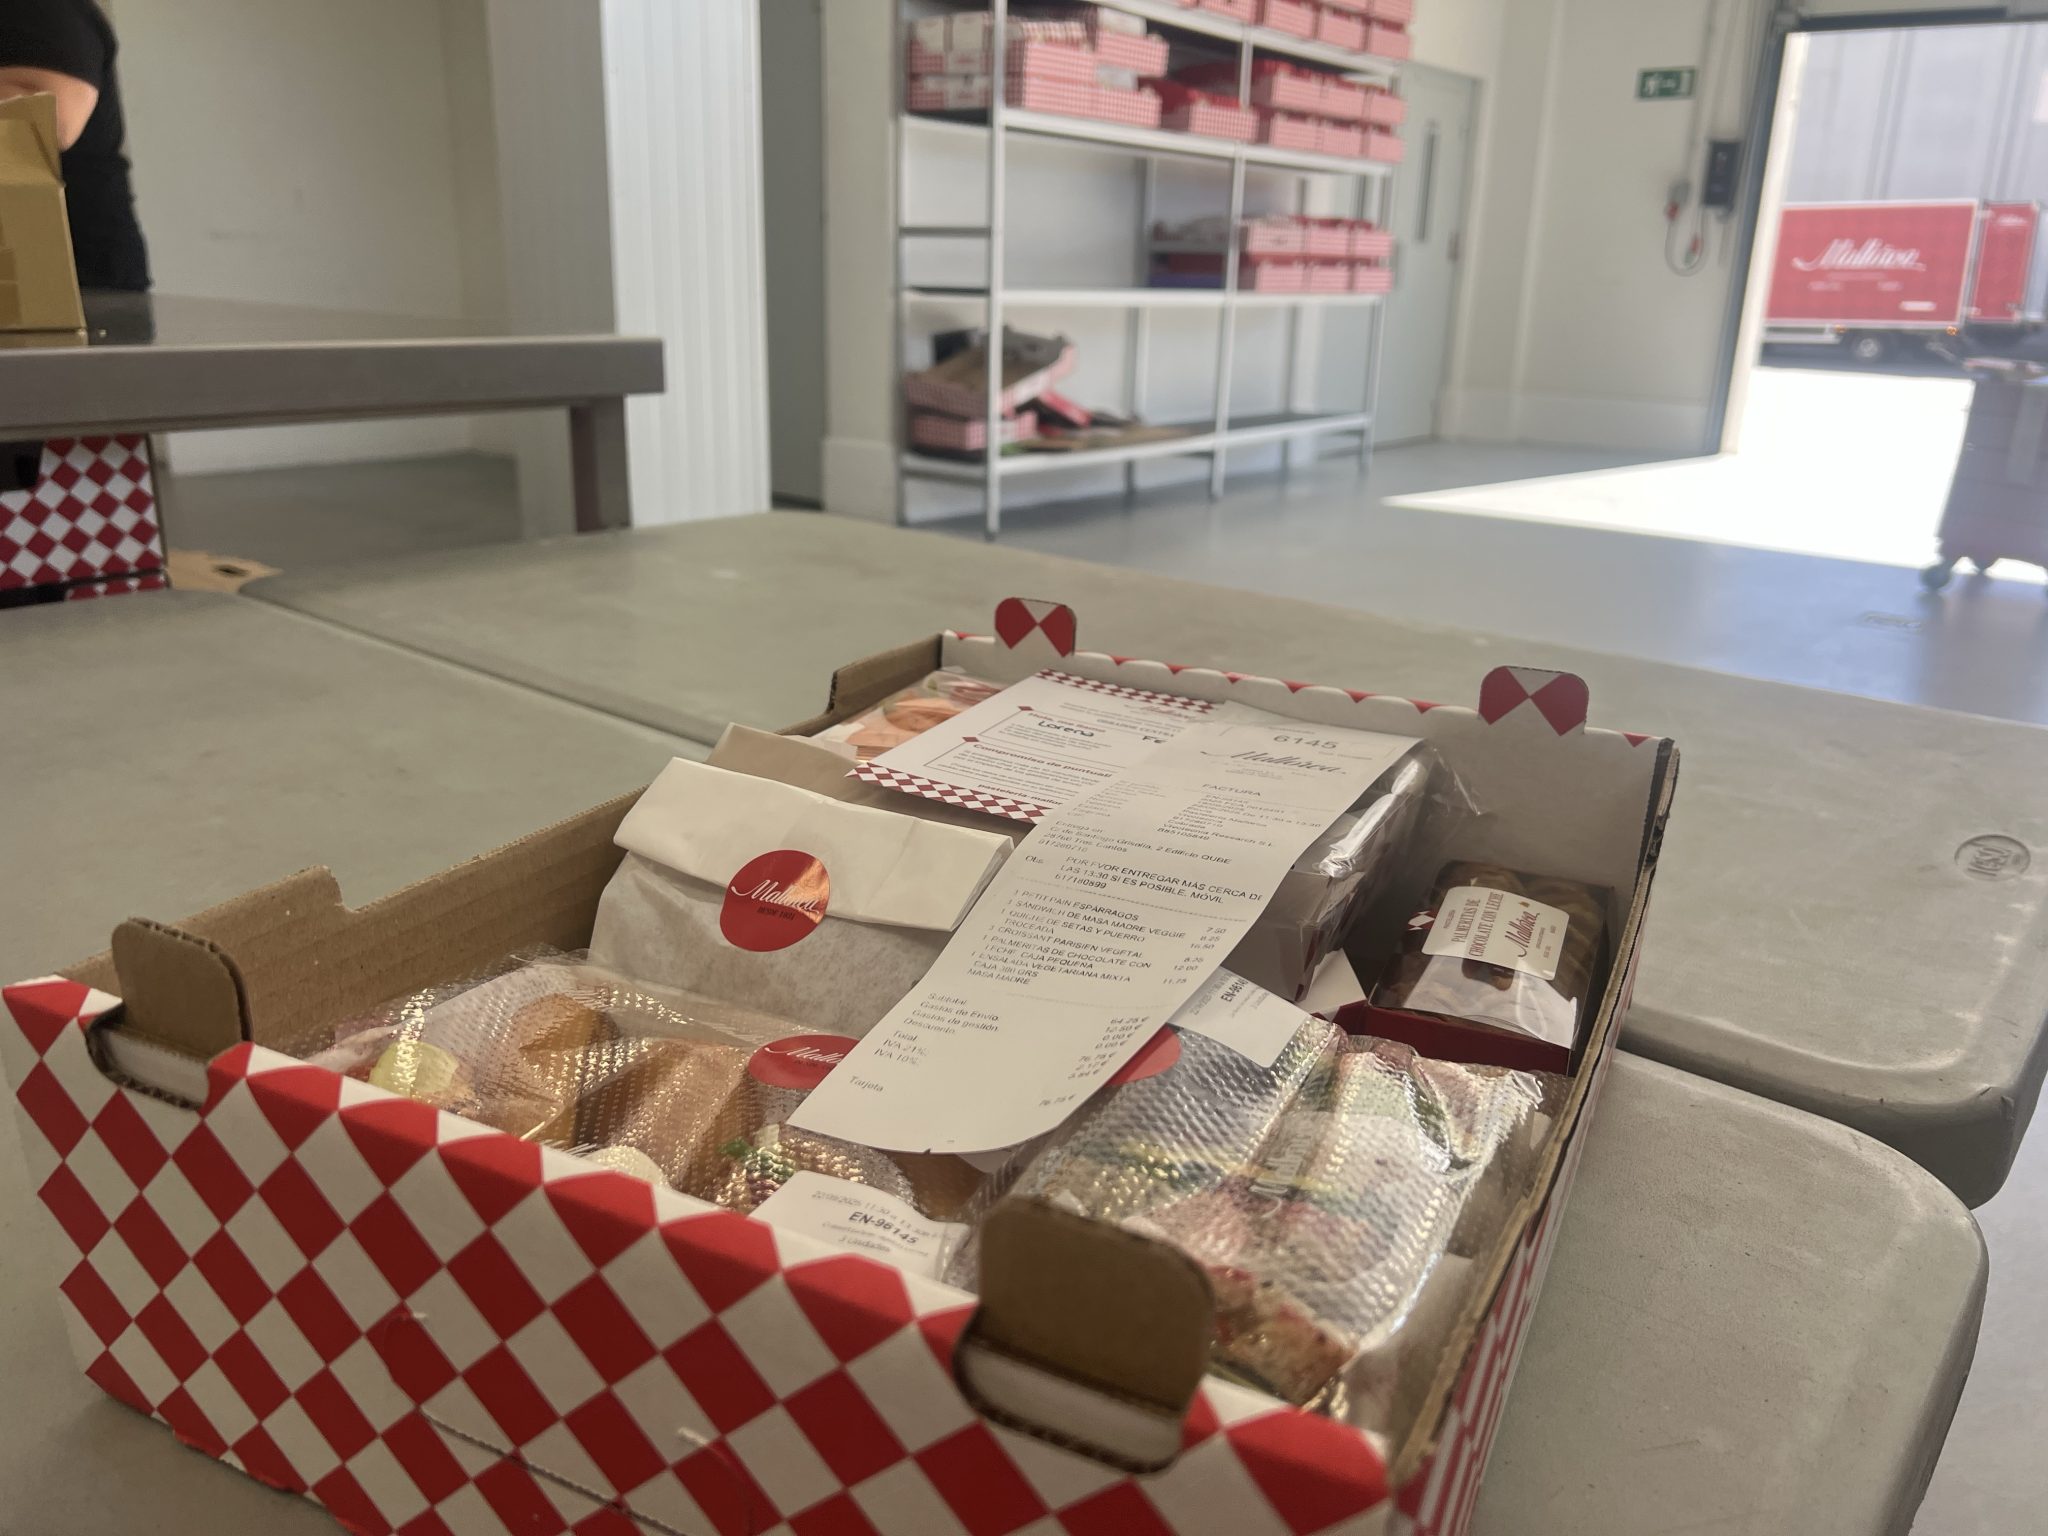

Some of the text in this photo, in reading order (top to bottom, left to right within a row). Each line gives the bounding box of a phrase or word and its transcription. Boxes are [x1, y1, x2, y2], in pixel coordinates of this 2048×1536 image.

[1038, 720, 1094, 737] Lorena
[1273, 735, 1338, 750] 6145
[973, 744, 1045, 764] Compromiso
[1202, 784, 1261, 796] FACTURA
[1095, 842, 1127, 853] Cantos
[1164, 847, 1199, 858] Edificio
[1201, 854, 1233, 865] QUBE
[1060, 864, 1081, 874] LAS
[1110, 874, 1122, 882] SI
[1122, 877, 1138, 886] ES
[1190, 891, 1224, 904] MÓVIL
[1066, 856, 1089, 866] POR
[1121, 867, 1180, 885] ENTREGAR
[1182, 880, 1206, 891] MÁS
[1208, 885, 1246, 898] CERCA
[731, 879, 820, 915] Mallorca
[1021, 890, 1048, 901] PETIT
[1049, 896, 1071, 906] PAIN
[1072, 902, 1140, 921] ESPÁRRAGOS
[1004, 918, 1055, 934] TROCEADA
[1067, 911, 1081, 920] DE
[1082, 914, 1109, 926] MASA
[1110, 919, 1147, 933] MADRE
[1148, 927, 1186, 939] VEGGIE
[1451, 898, 1481, 943] PALMERITAS DE
[1468, 891, 1505, 957] CHOCOLATE CON LECHE
[1046, 918, 1061, 926] DE
[1061, 921, 1093, 933] SETAS
[1103, 930, 1146, 943] PUERRO
[1504, 910, 1541, 958] Mallorca
[990, 935, 1051, 954] PALMERITAS
[1051, 949, 1064, 957] DE
[1066, 951, 1128, 968] CHOCOLATE
[1128, 961, 1153, 969] CON
[998, 926, 1053, 943] CROISSANT
[1053, 937, 1099, 952] PARISIEN
[1100, 947, 1143, 959] VEGETAL
[973, 960, 997, 970] CAJA
[1020, 951, 1045, 962] CAJA
[966, 968, 1031, 986] MASA MADRE
[978, 953, 1029, 968] ENSALADA
[1031, 962, 1098, 979] VEGETARIANA
[1099, 973, 1131, 983] MIXTA
[911, 1009, 946, 1024] Gastos
[947, 1018, 961, 1026] de
[919, 1001, 954, 1015] Gastos
[955, 1009, 969, 1018] de
[874, 1048, 893, 1060] IVA
[882, 1039, 902, 1050] IVA
[849, 1075, 885, 1093] Tarjeta
[848, 1210, 919, 1244] EN-96145
